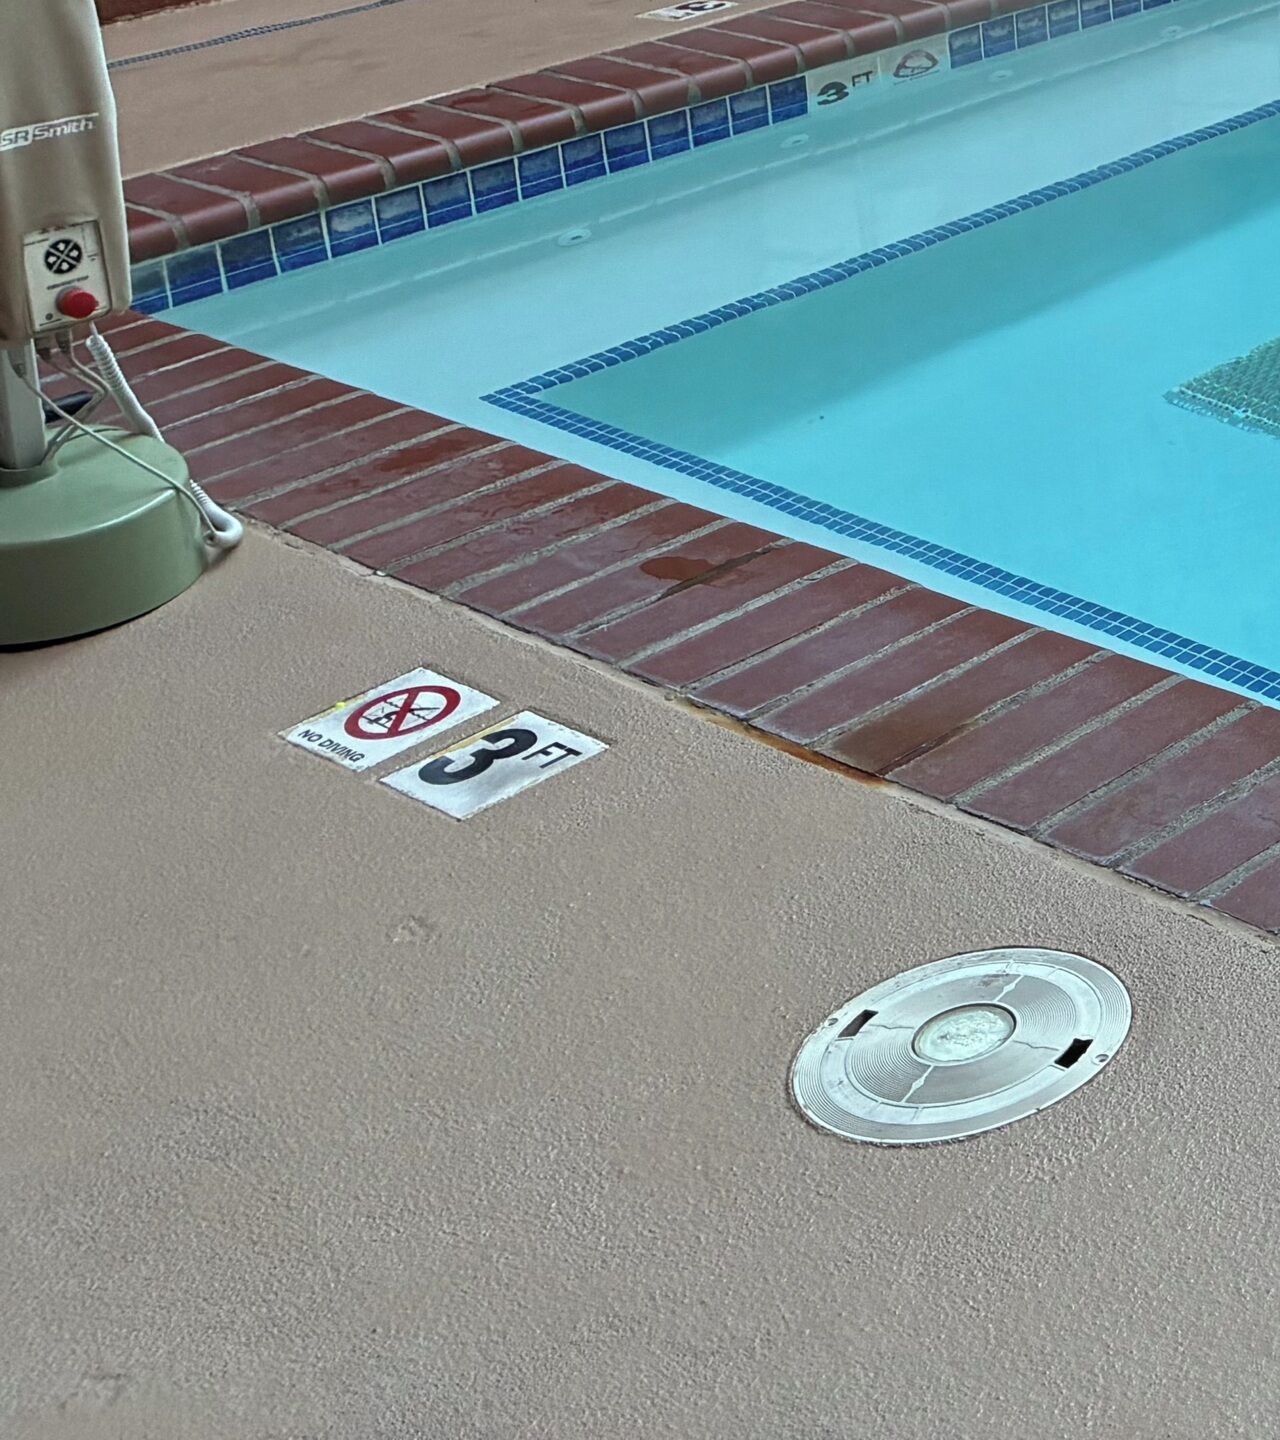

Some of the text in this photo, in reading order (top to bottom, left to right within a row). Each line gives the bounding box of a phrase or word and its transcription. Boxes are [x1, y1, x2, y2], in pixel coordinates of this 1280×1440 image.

[816, 81, 850, 106] 3
[851, 70, 874, 88] FT
[33, 118, 94, 140] Smith
[297, 728, 367, 763] NO DIVING
[417, 727, 583, 786] 3 FT
